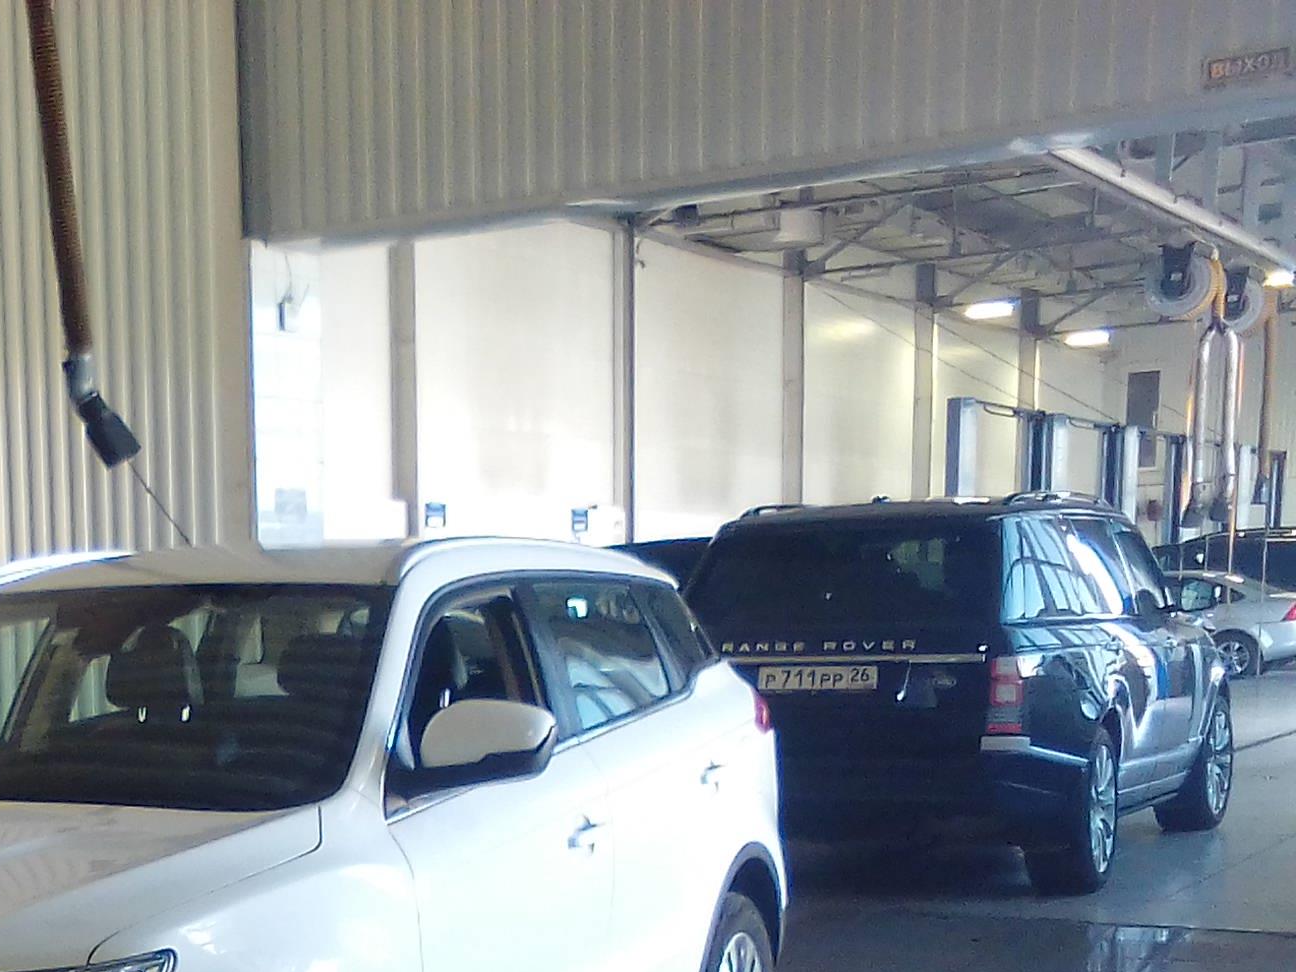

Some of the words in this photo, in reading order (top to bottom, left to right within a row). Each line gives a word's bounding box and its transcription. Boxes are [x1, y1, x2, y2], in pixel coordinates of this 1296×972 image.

[721, 641, 805, 653] RANGE
[823, 639, 917, 651] ROVER
[850, 667, 870, 683] 26
